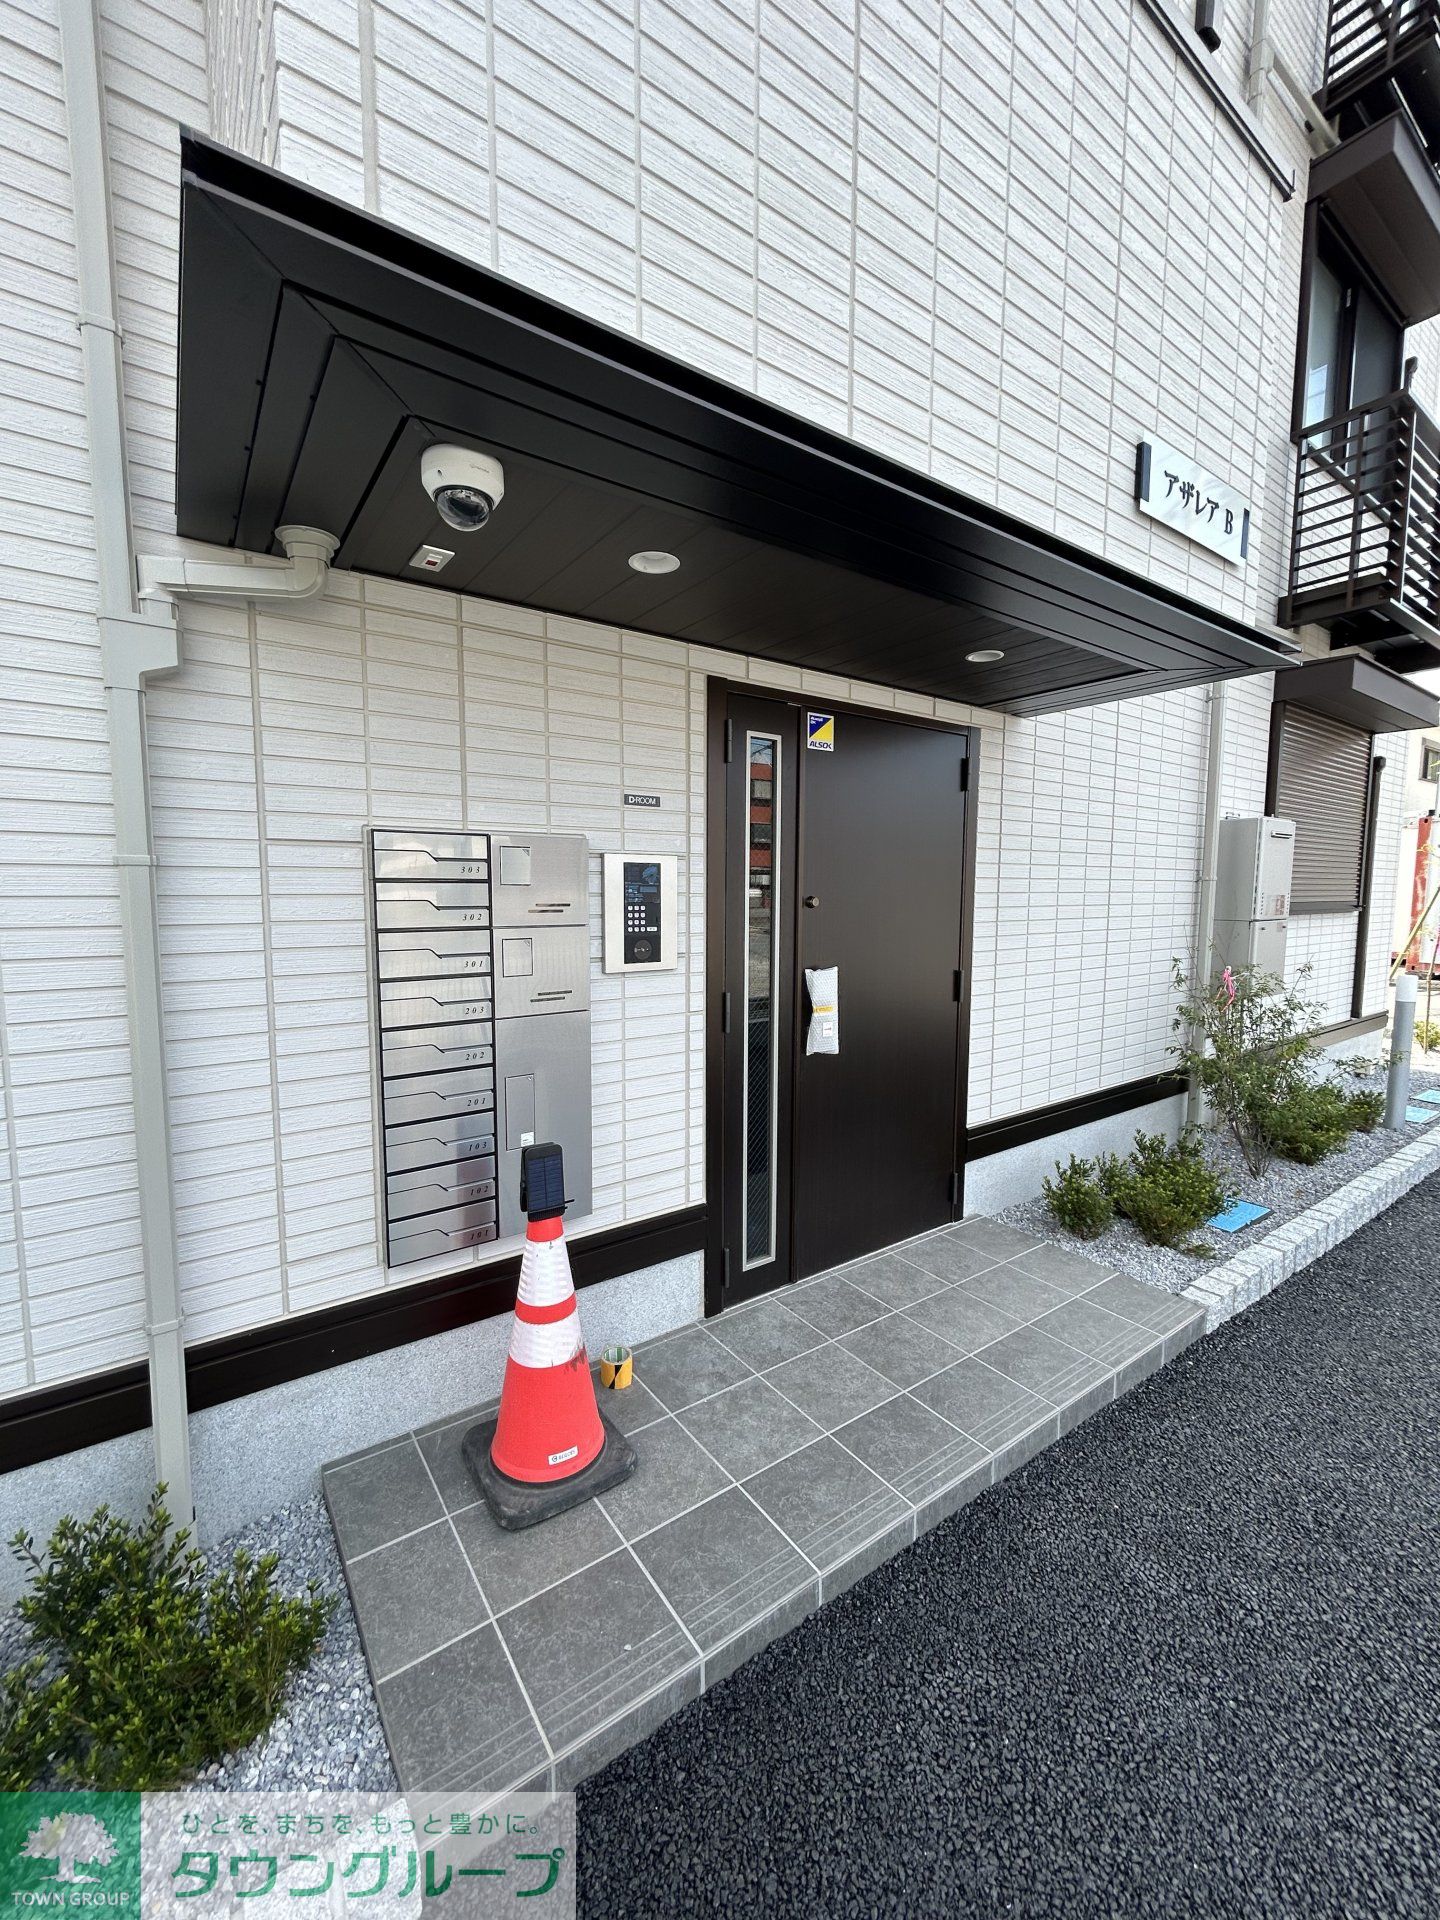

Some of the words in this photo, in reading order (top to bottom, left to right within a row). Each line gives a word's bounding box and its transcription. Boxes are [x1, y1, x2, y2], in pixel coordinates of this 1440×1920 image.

[1164, 469, 1220, 523] アザレア
[1223, 508, 1234, 535] B
[809, 740, 832, 749] ALSOK
[460, 866, 480, 874] 303
[462, 913, 482, 921] 302
[464, 960, 483, 968] 301
[465, 1006, 485, 1015] 203
[465, 1051, 485, 1061] 202
[467, 1097, 486, 1106] 201
[468, 1141, 488, 1151] 103
[470, 1186, 489, 1195] 102
